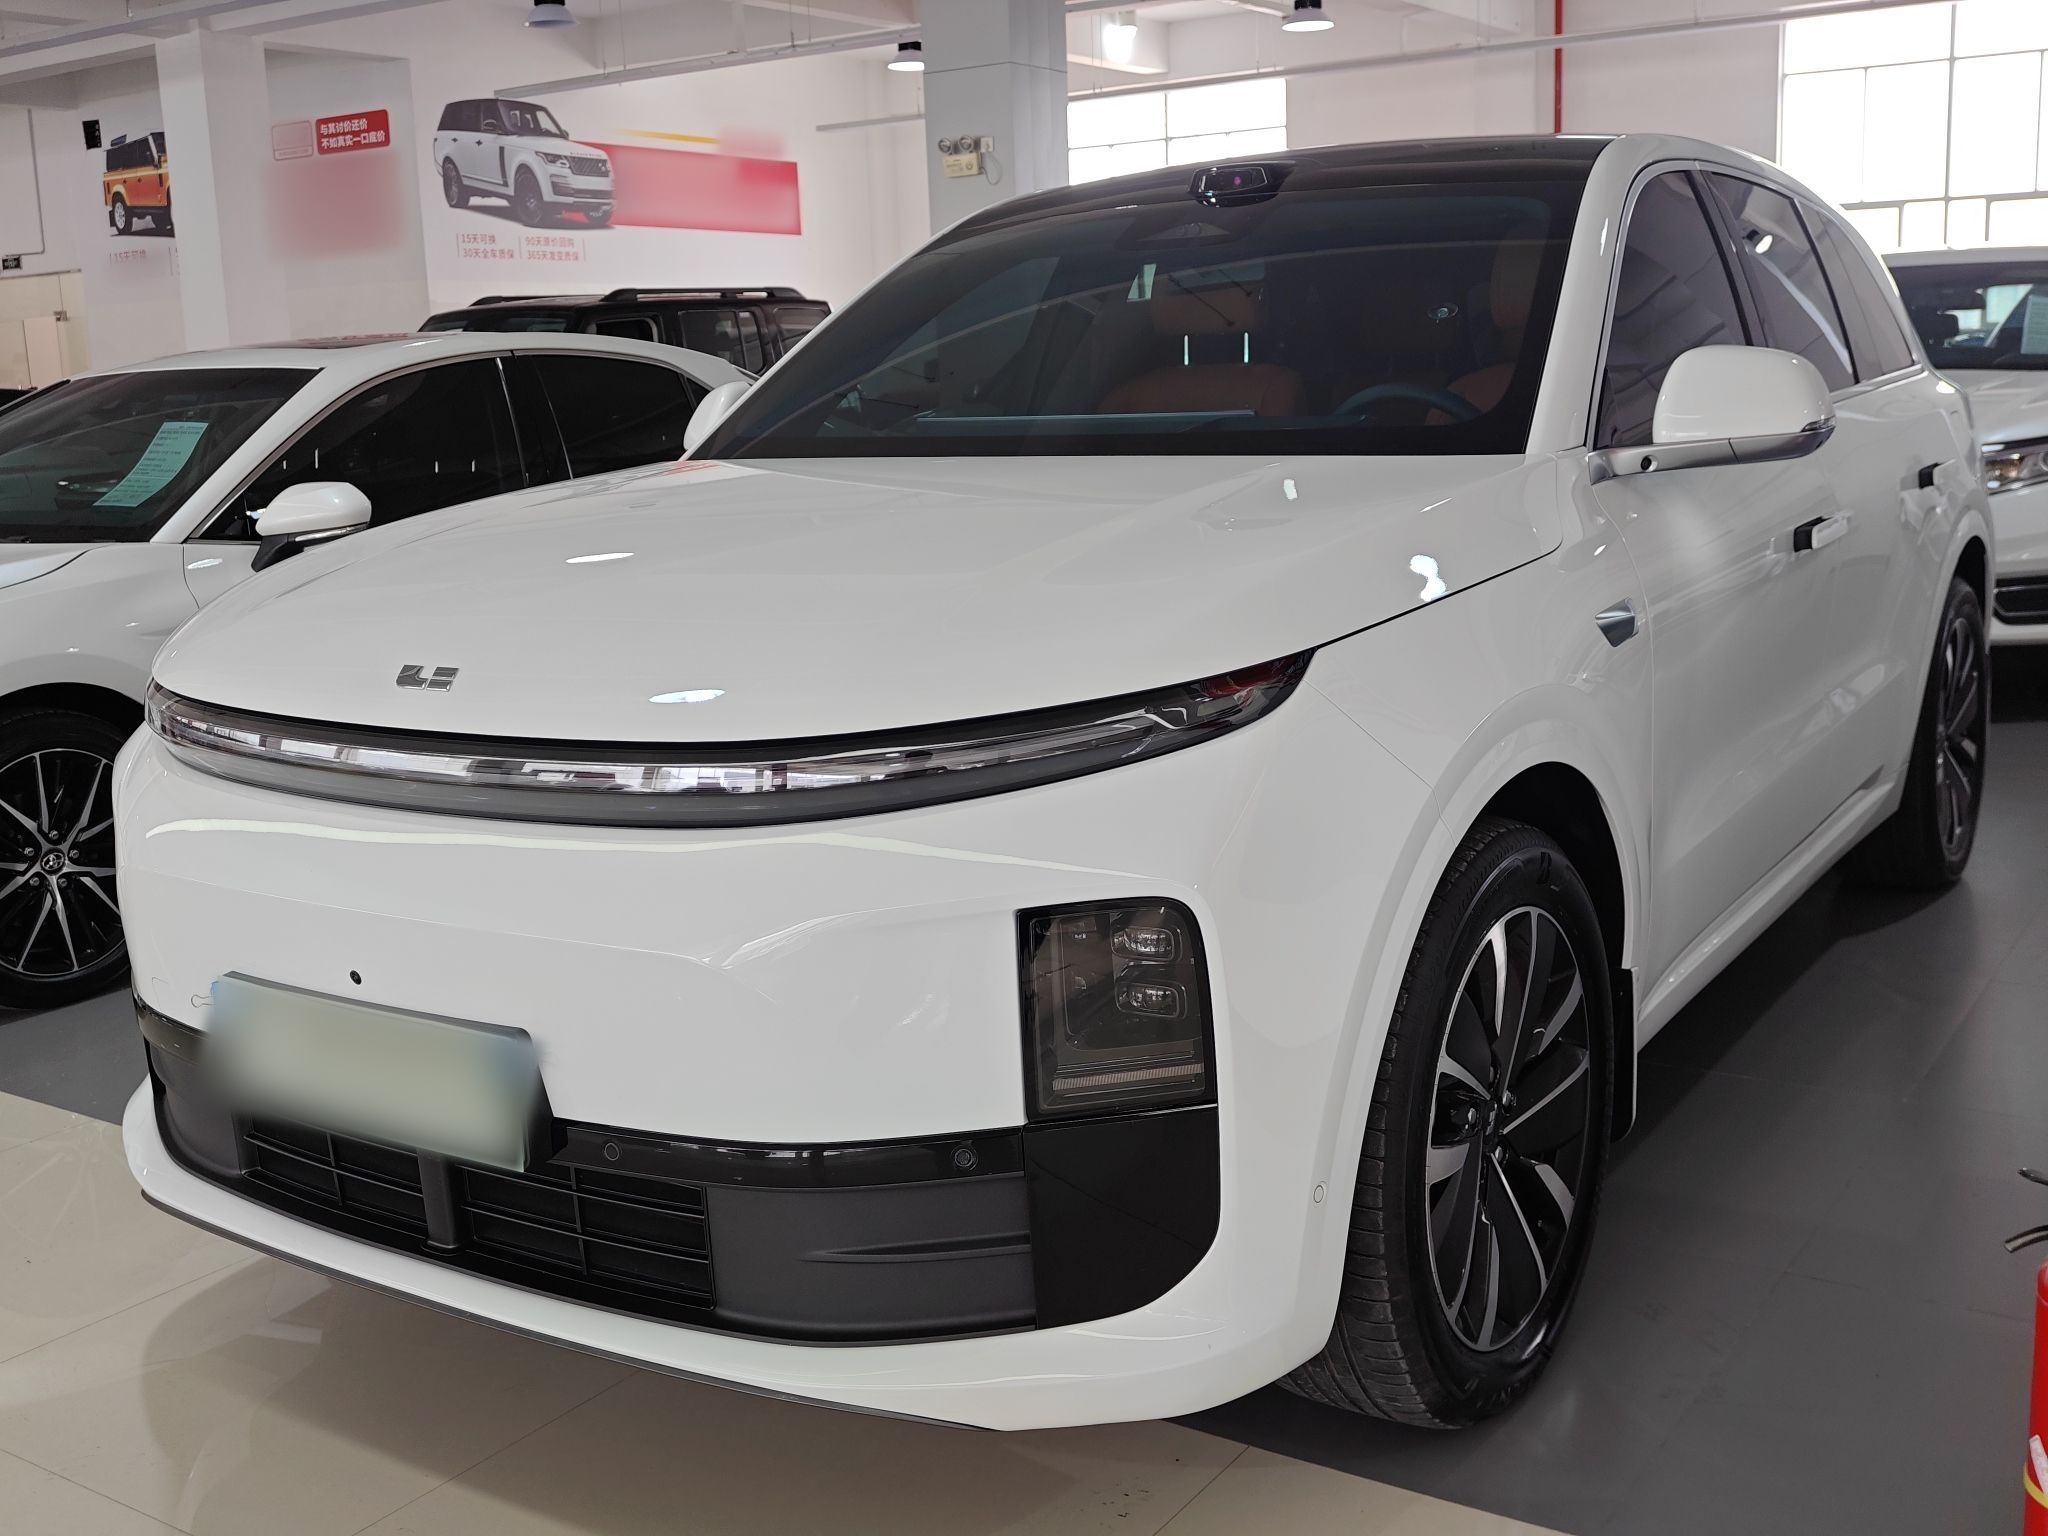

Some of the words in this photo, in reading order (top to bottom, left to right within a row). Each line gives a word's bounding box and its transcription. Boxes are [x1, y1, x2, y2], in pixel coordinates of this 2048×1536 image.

[320, 118, 367, 135] 与其讨价还价
[321, 130, 385, 149] 不如真实一口底价
[461, 234, 496, 245] 15天可换
[463, 248, 514, 259] 30天全车质保
